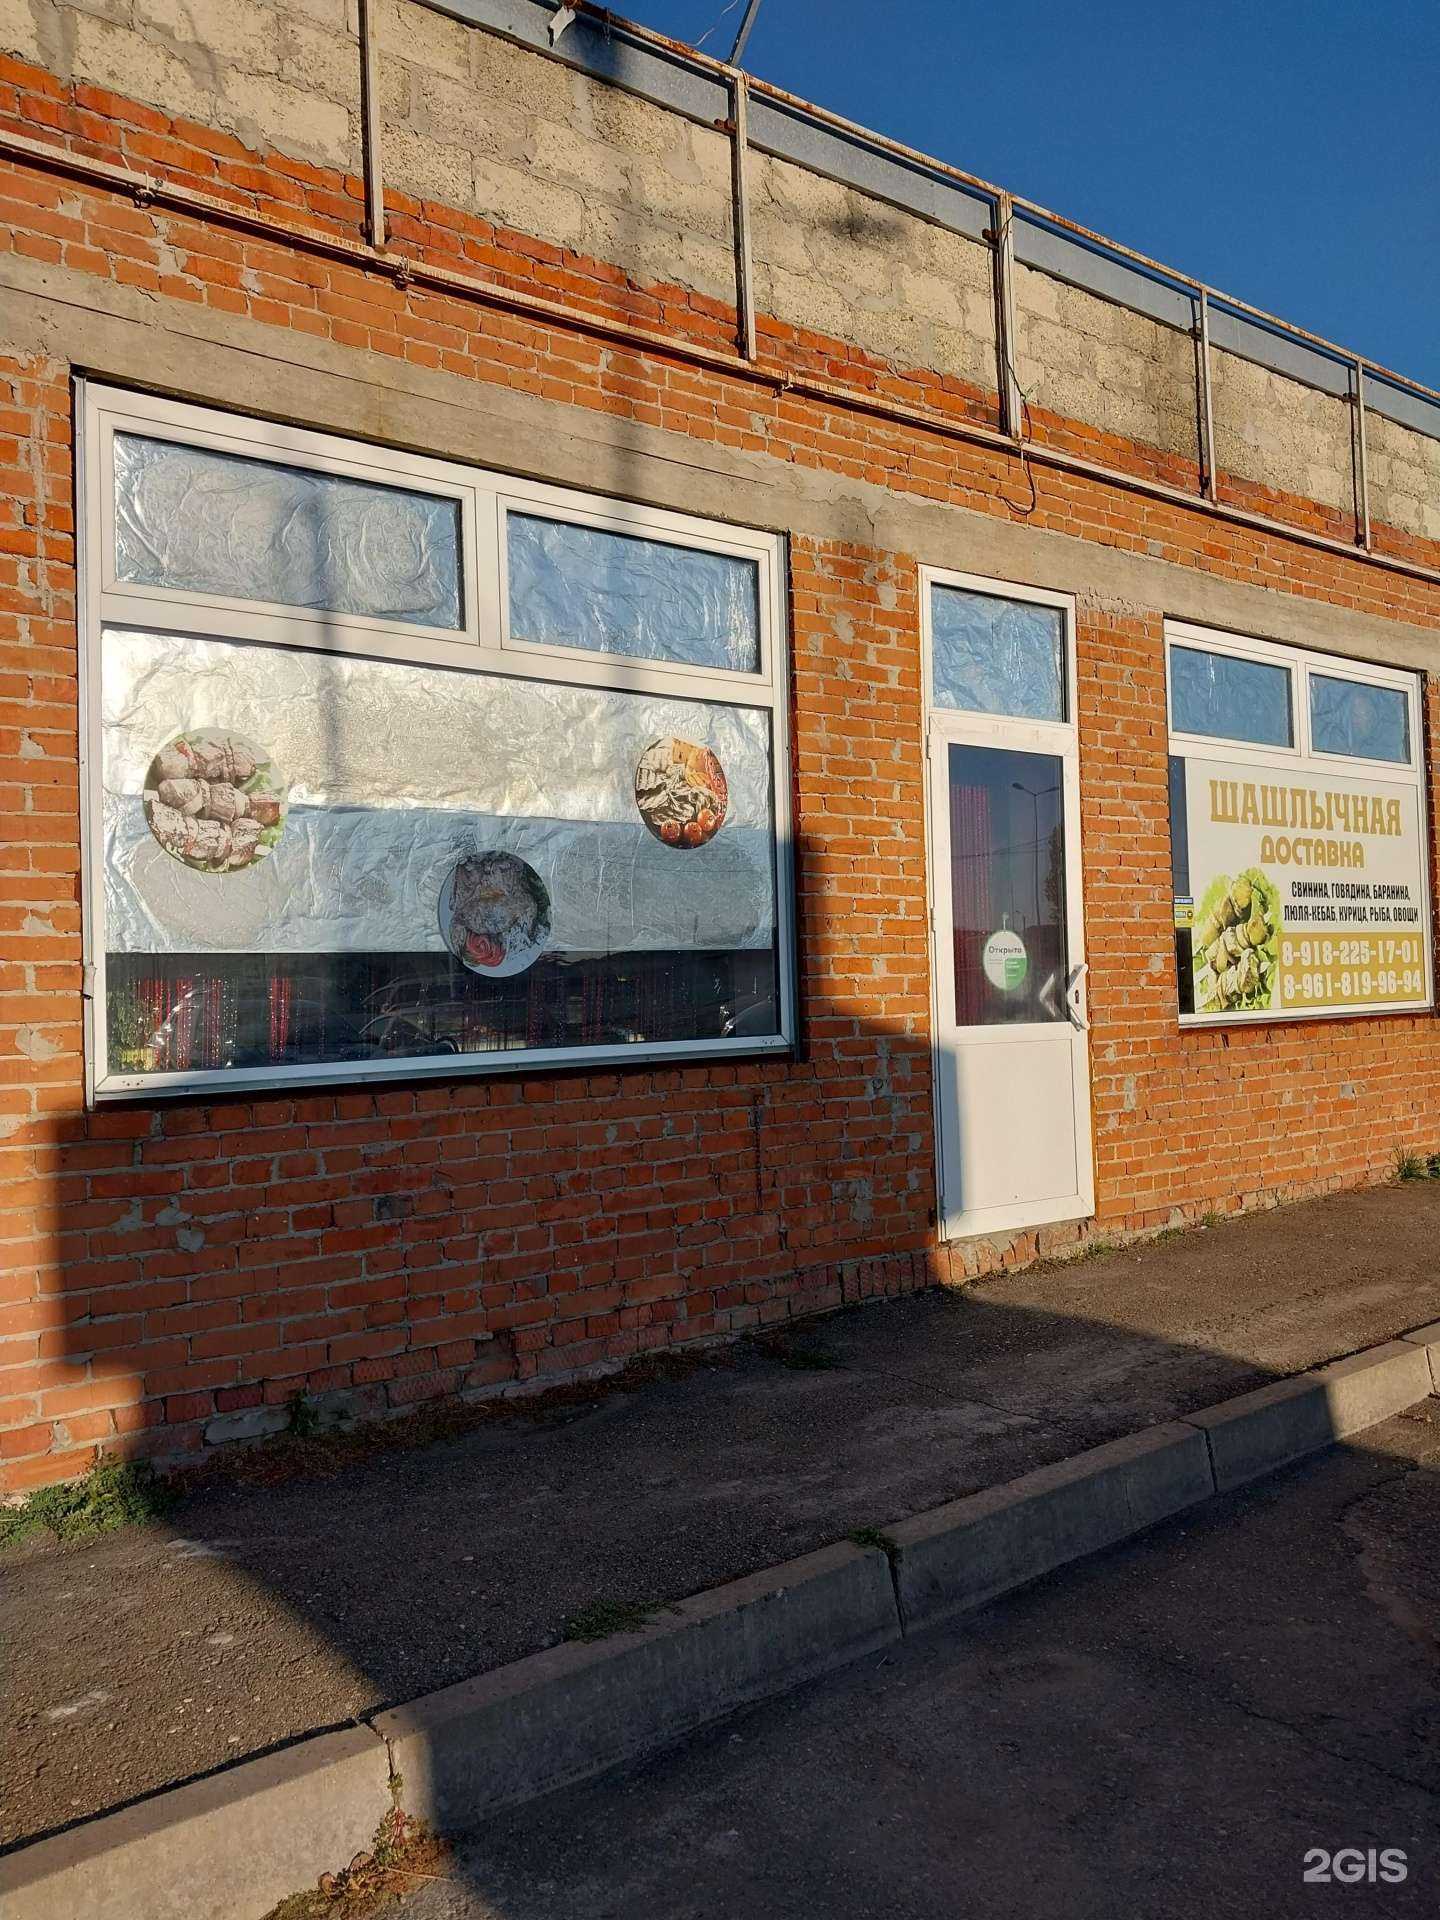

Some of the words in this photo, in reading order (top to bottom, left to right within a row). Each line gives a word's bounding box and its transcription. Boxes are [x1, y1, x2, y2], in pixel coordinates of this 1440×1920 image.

[1209, 779, 1402, 836] ШАШЛЫЧНАЯ
[1260, 835, 1365, 868] ДОСТАВКА
[1291, 881, 1330, 899] СВИНИНА,
[1331, 883, 1372, 901] ГОВЯДИНА,
[1373, 884, 1411, 901] БАРАНИНА,
[1284, 905, 1337, 922] ЛЮЛЯ-КЕБАБ,
[1339, 906, 1368, 924] КУРИЦА,
[1369, 906, 1392, 922] РЫБА,
[1393, 907, 1418, 924] ОВОЩИ
[1282, 940, 1419, 967] 8-918-225-17-01
[1283, 969, 1422, 999] 8-961-819-96-94
